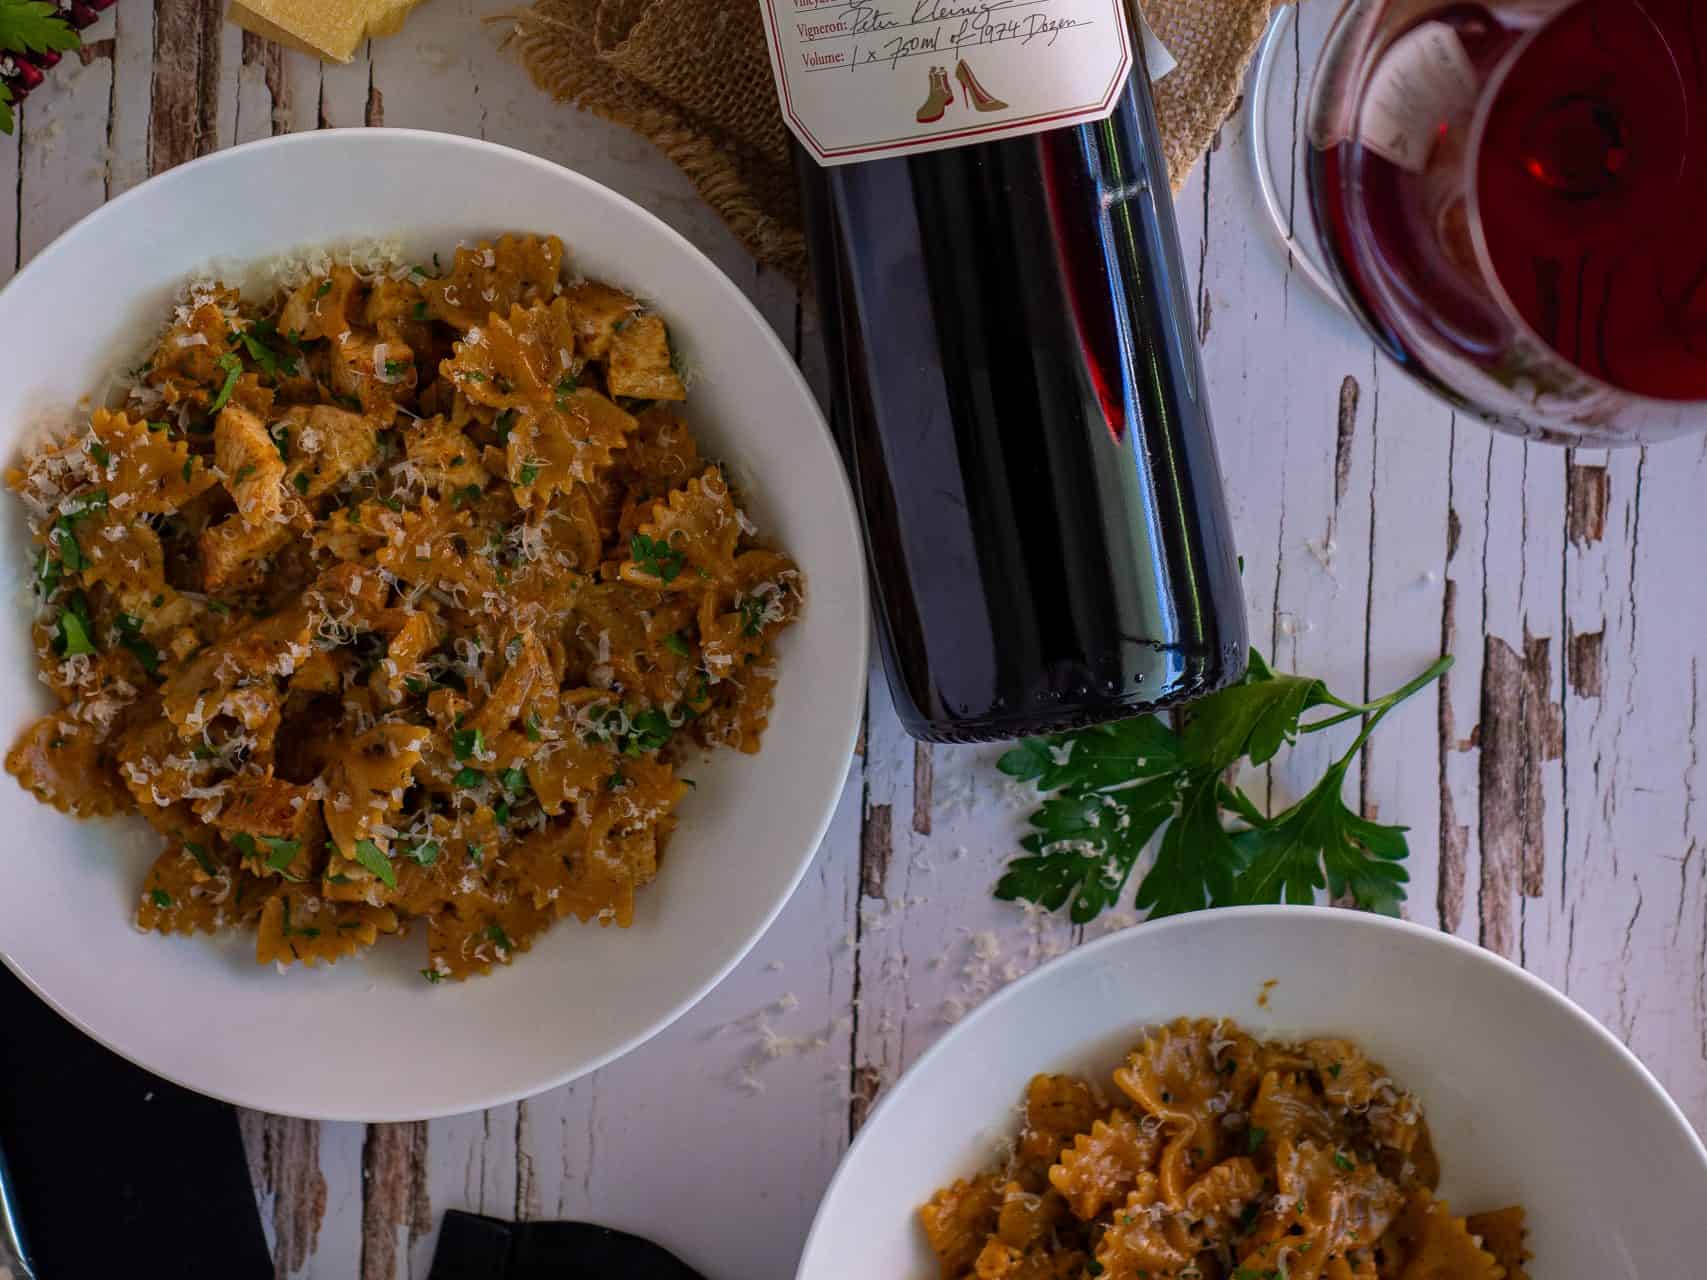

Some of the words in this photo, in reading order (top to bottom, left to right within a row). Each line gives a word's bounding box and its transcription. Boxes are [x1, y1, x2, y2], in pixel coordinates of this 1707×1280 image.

[797, 19, 849, 37] Vigneron:
[839, 8, 898, 35] Peter
[801, 52, 845, 66] Volume:
[1021, 14, 1078, 46] Dozen
